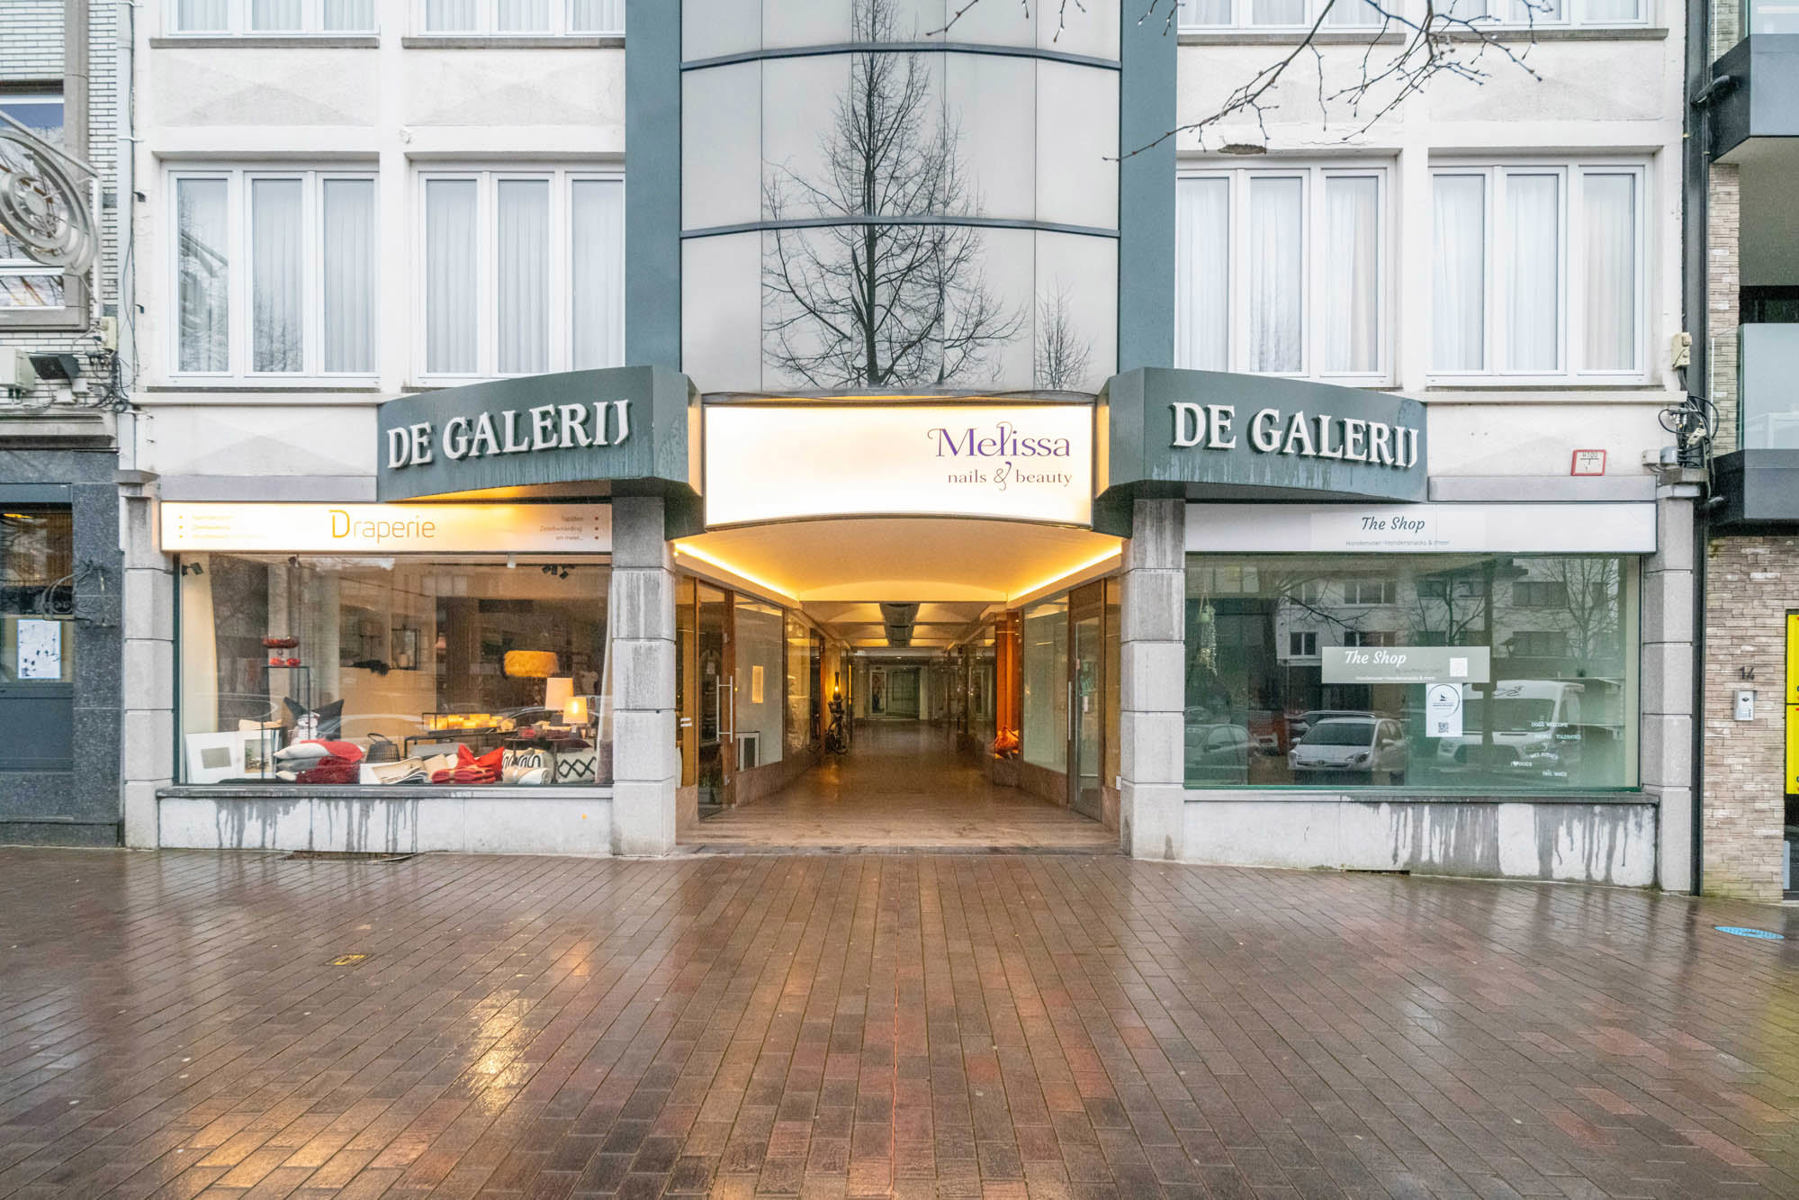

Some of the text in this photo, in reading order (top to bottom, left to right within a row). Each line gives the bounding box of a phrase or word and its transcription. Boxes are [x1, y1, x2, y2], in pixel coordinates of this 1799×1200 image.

[387, 398, 631, 469] DE GALERIJ
[927, 420, 1071, 458] Melissa
[1170, 401, 1420, 469] DE GALERIJ
[948, 461, 1073, 491] nails & beauty
[328, 509, 436, 545] Draperie
[1361, 516, 1425, 534] The Shop
[1344, 650, 1408, 668] The Shop
